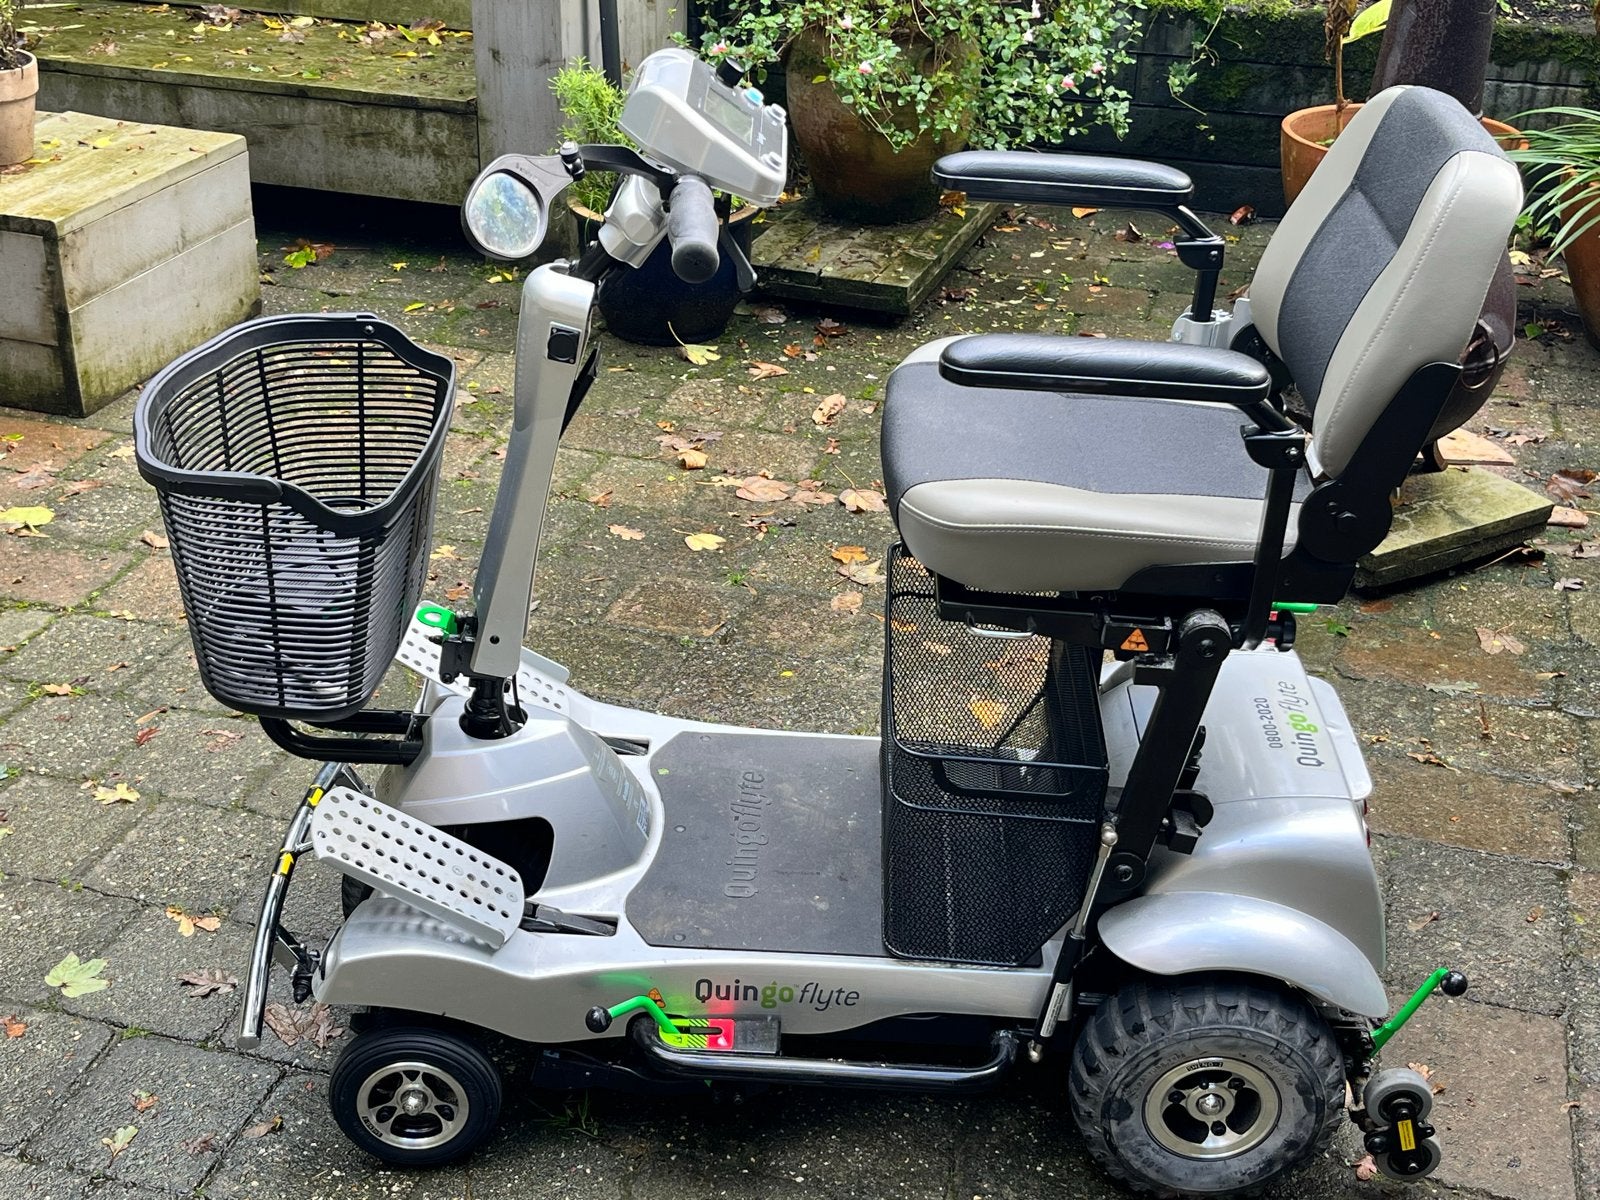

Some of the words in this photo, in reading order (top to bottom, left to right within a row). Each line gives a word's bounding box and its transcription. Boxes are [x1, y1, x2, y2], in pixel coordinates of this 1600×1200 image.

[1277, 680, 1309, 713] flyte
[1253, 697, 1284, 749] 0800-2020
[1287, 714, 1325, 767] Quingo
[695, 978, 794, 1009] Quingo
[798, 982, 860, 1012] flyte
